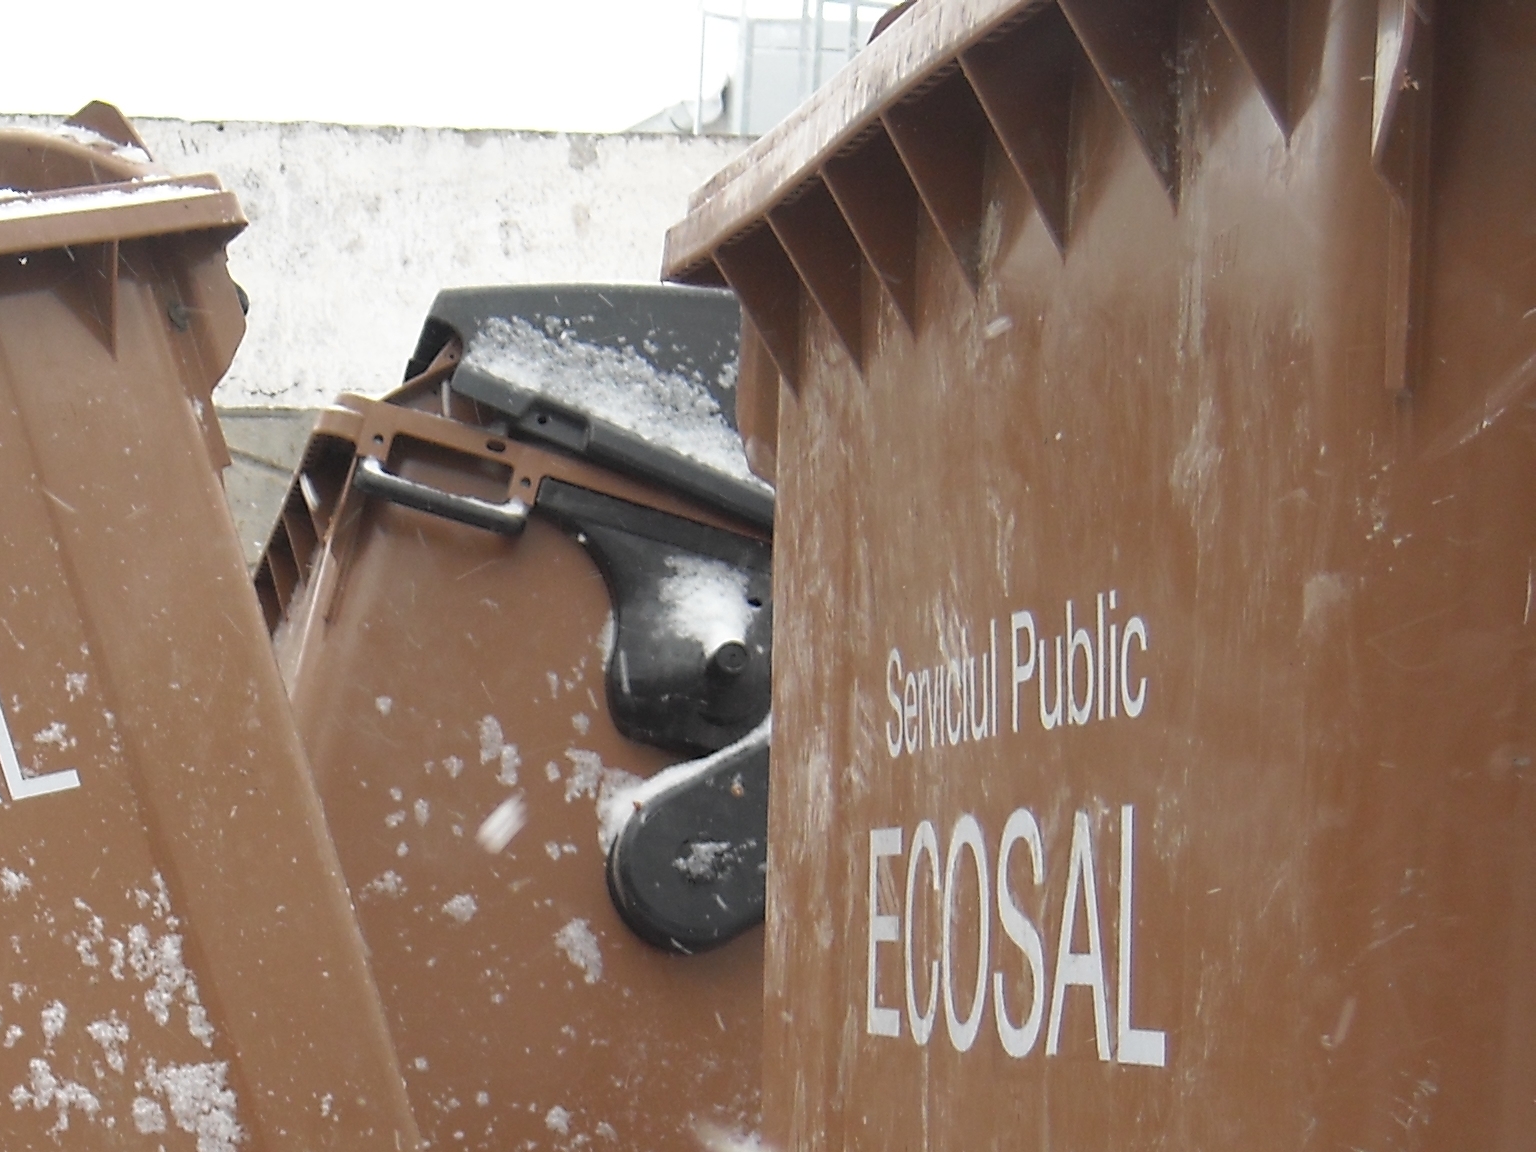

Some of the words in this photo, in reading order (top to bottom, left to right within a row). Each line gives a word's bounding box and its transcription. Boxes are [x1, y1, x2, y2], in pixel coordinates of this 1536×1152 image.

[885, 618, 998, 758] Serviciul
[1010, 590, 1148, 733] Public
[866, 805, 1166, 1068] ECOSAL
